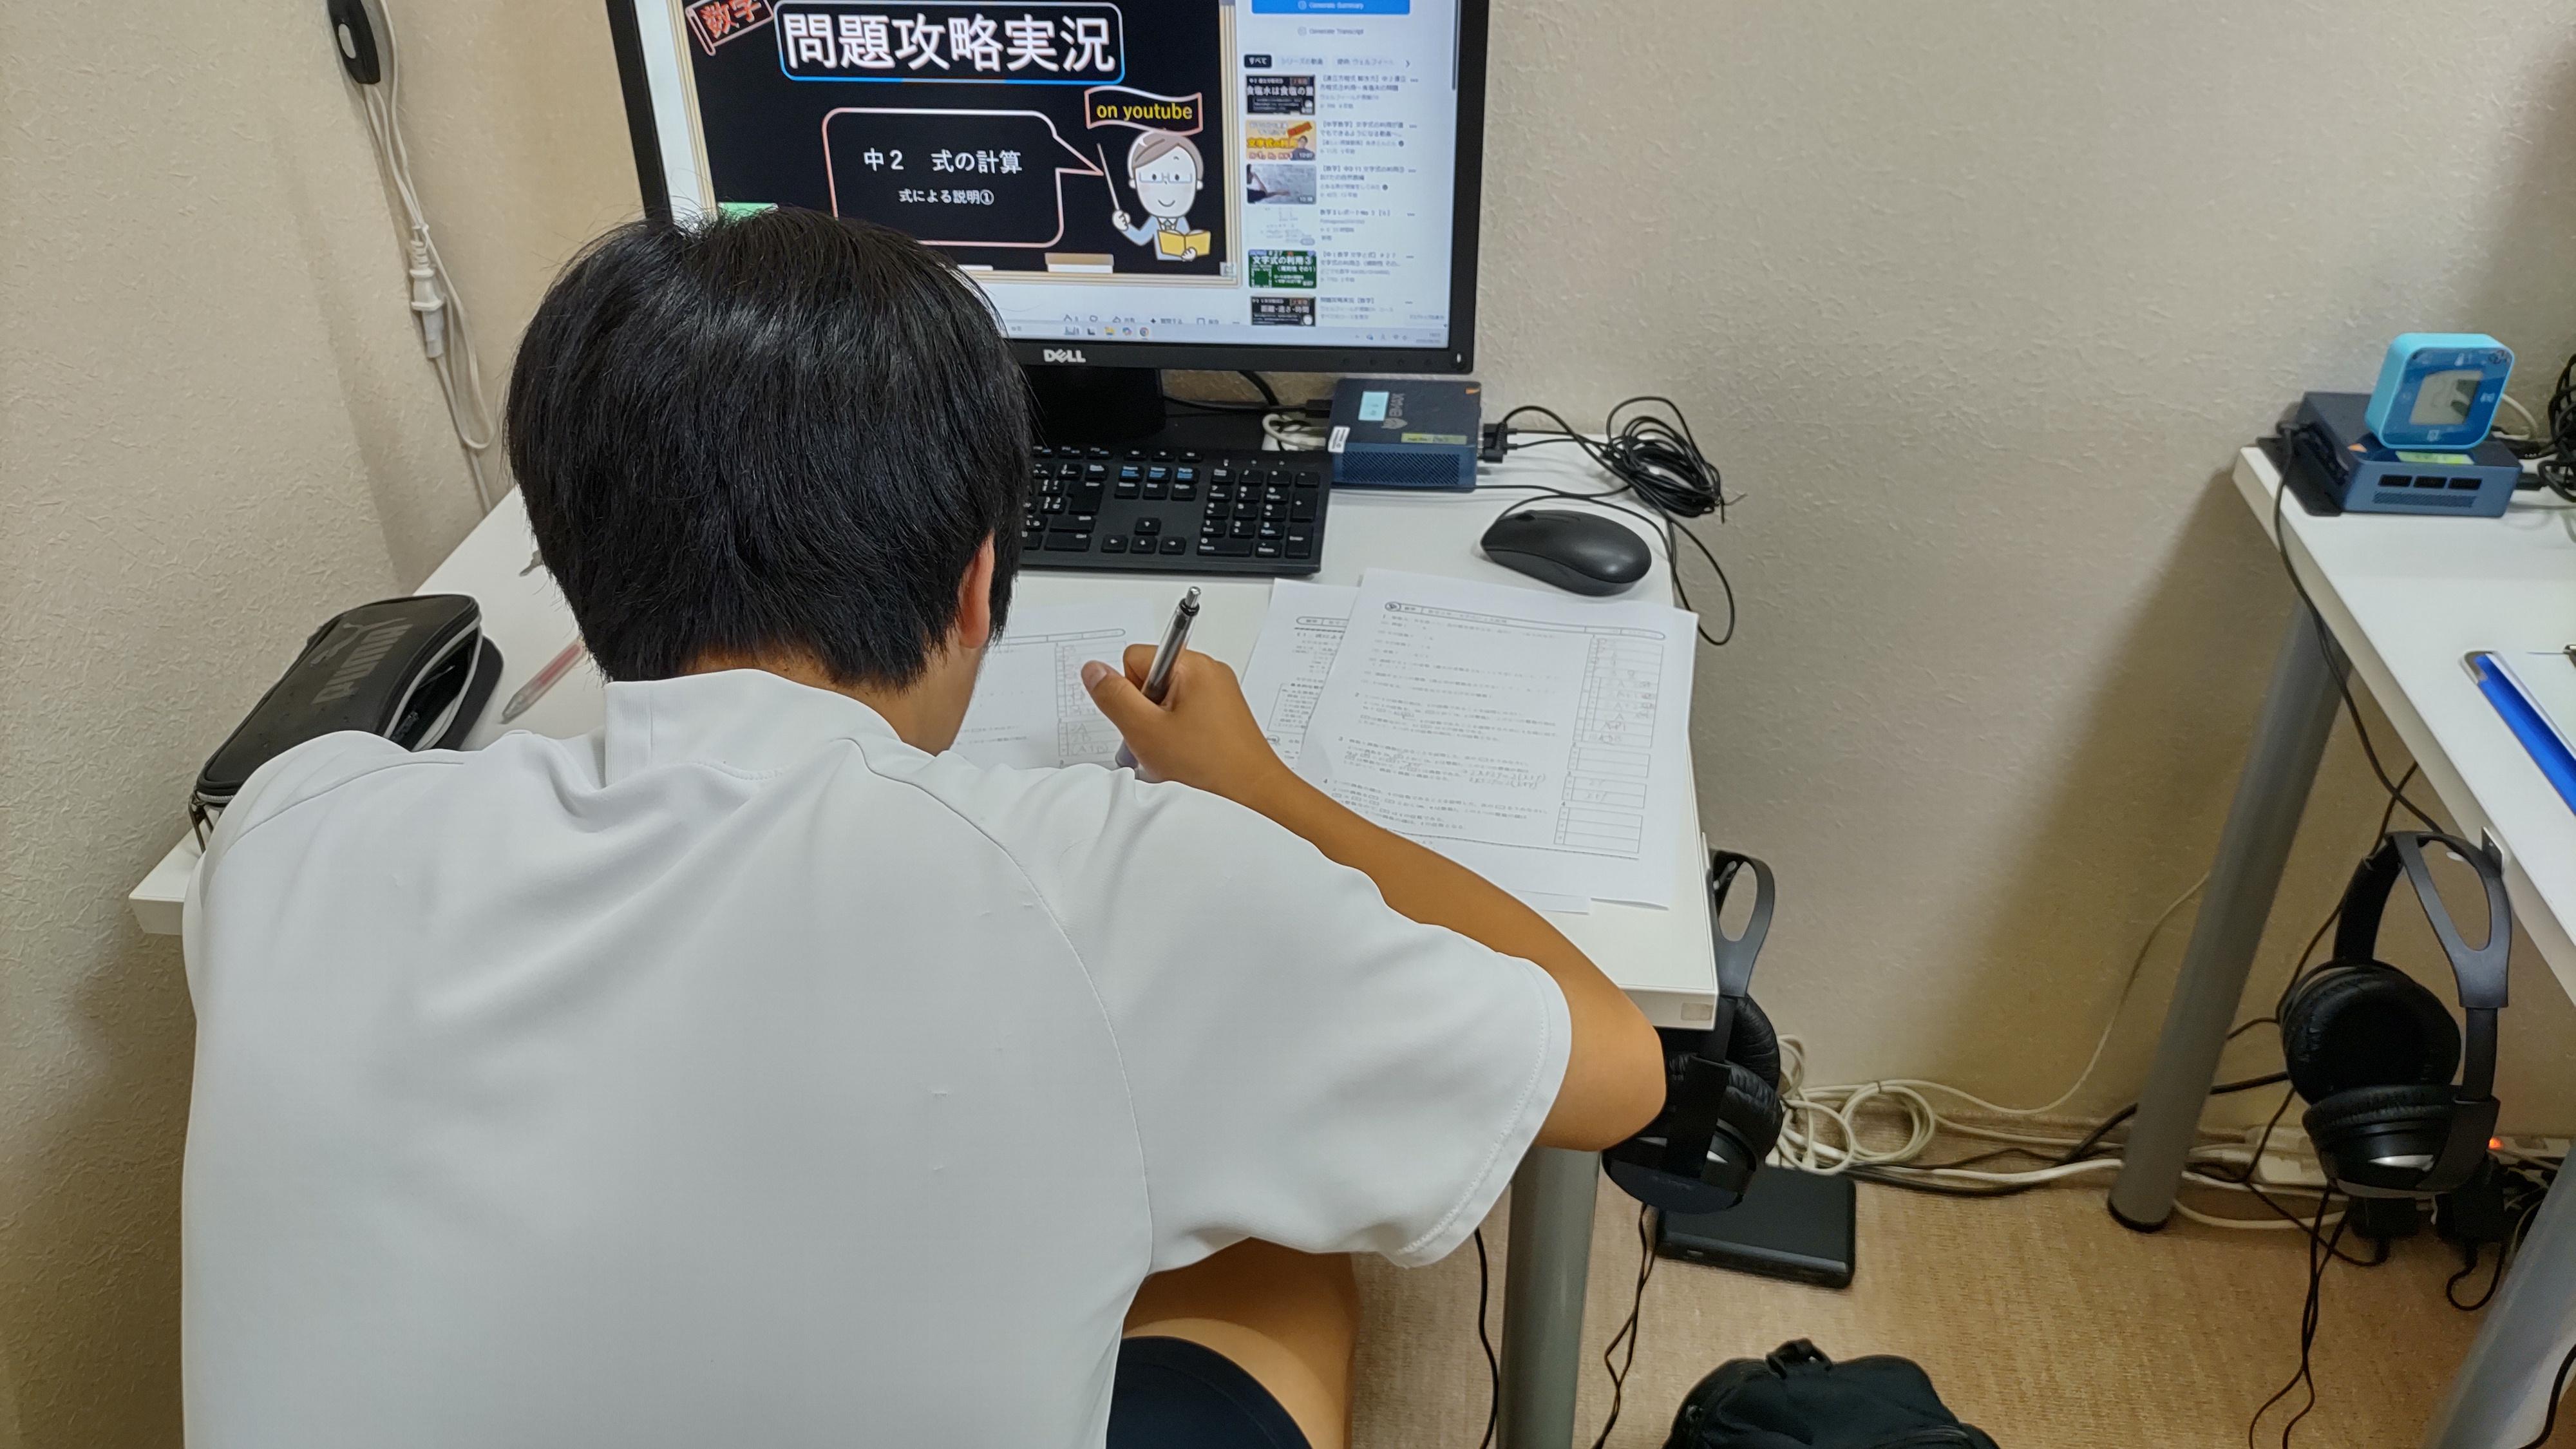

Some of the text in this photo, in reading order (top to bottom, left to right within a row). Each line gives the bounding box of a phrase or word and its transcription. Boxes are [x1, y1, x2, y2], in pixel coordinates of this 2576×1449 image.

[782, 13, 1116, 71] 問題攻略実況
[1096, 102, 1193, 121] on youtube
[931, 149, 1023, 174] 式の計算
[898, 188, 995, 205] 式による説明①
[1043, 348, 1086, 363] DELL
